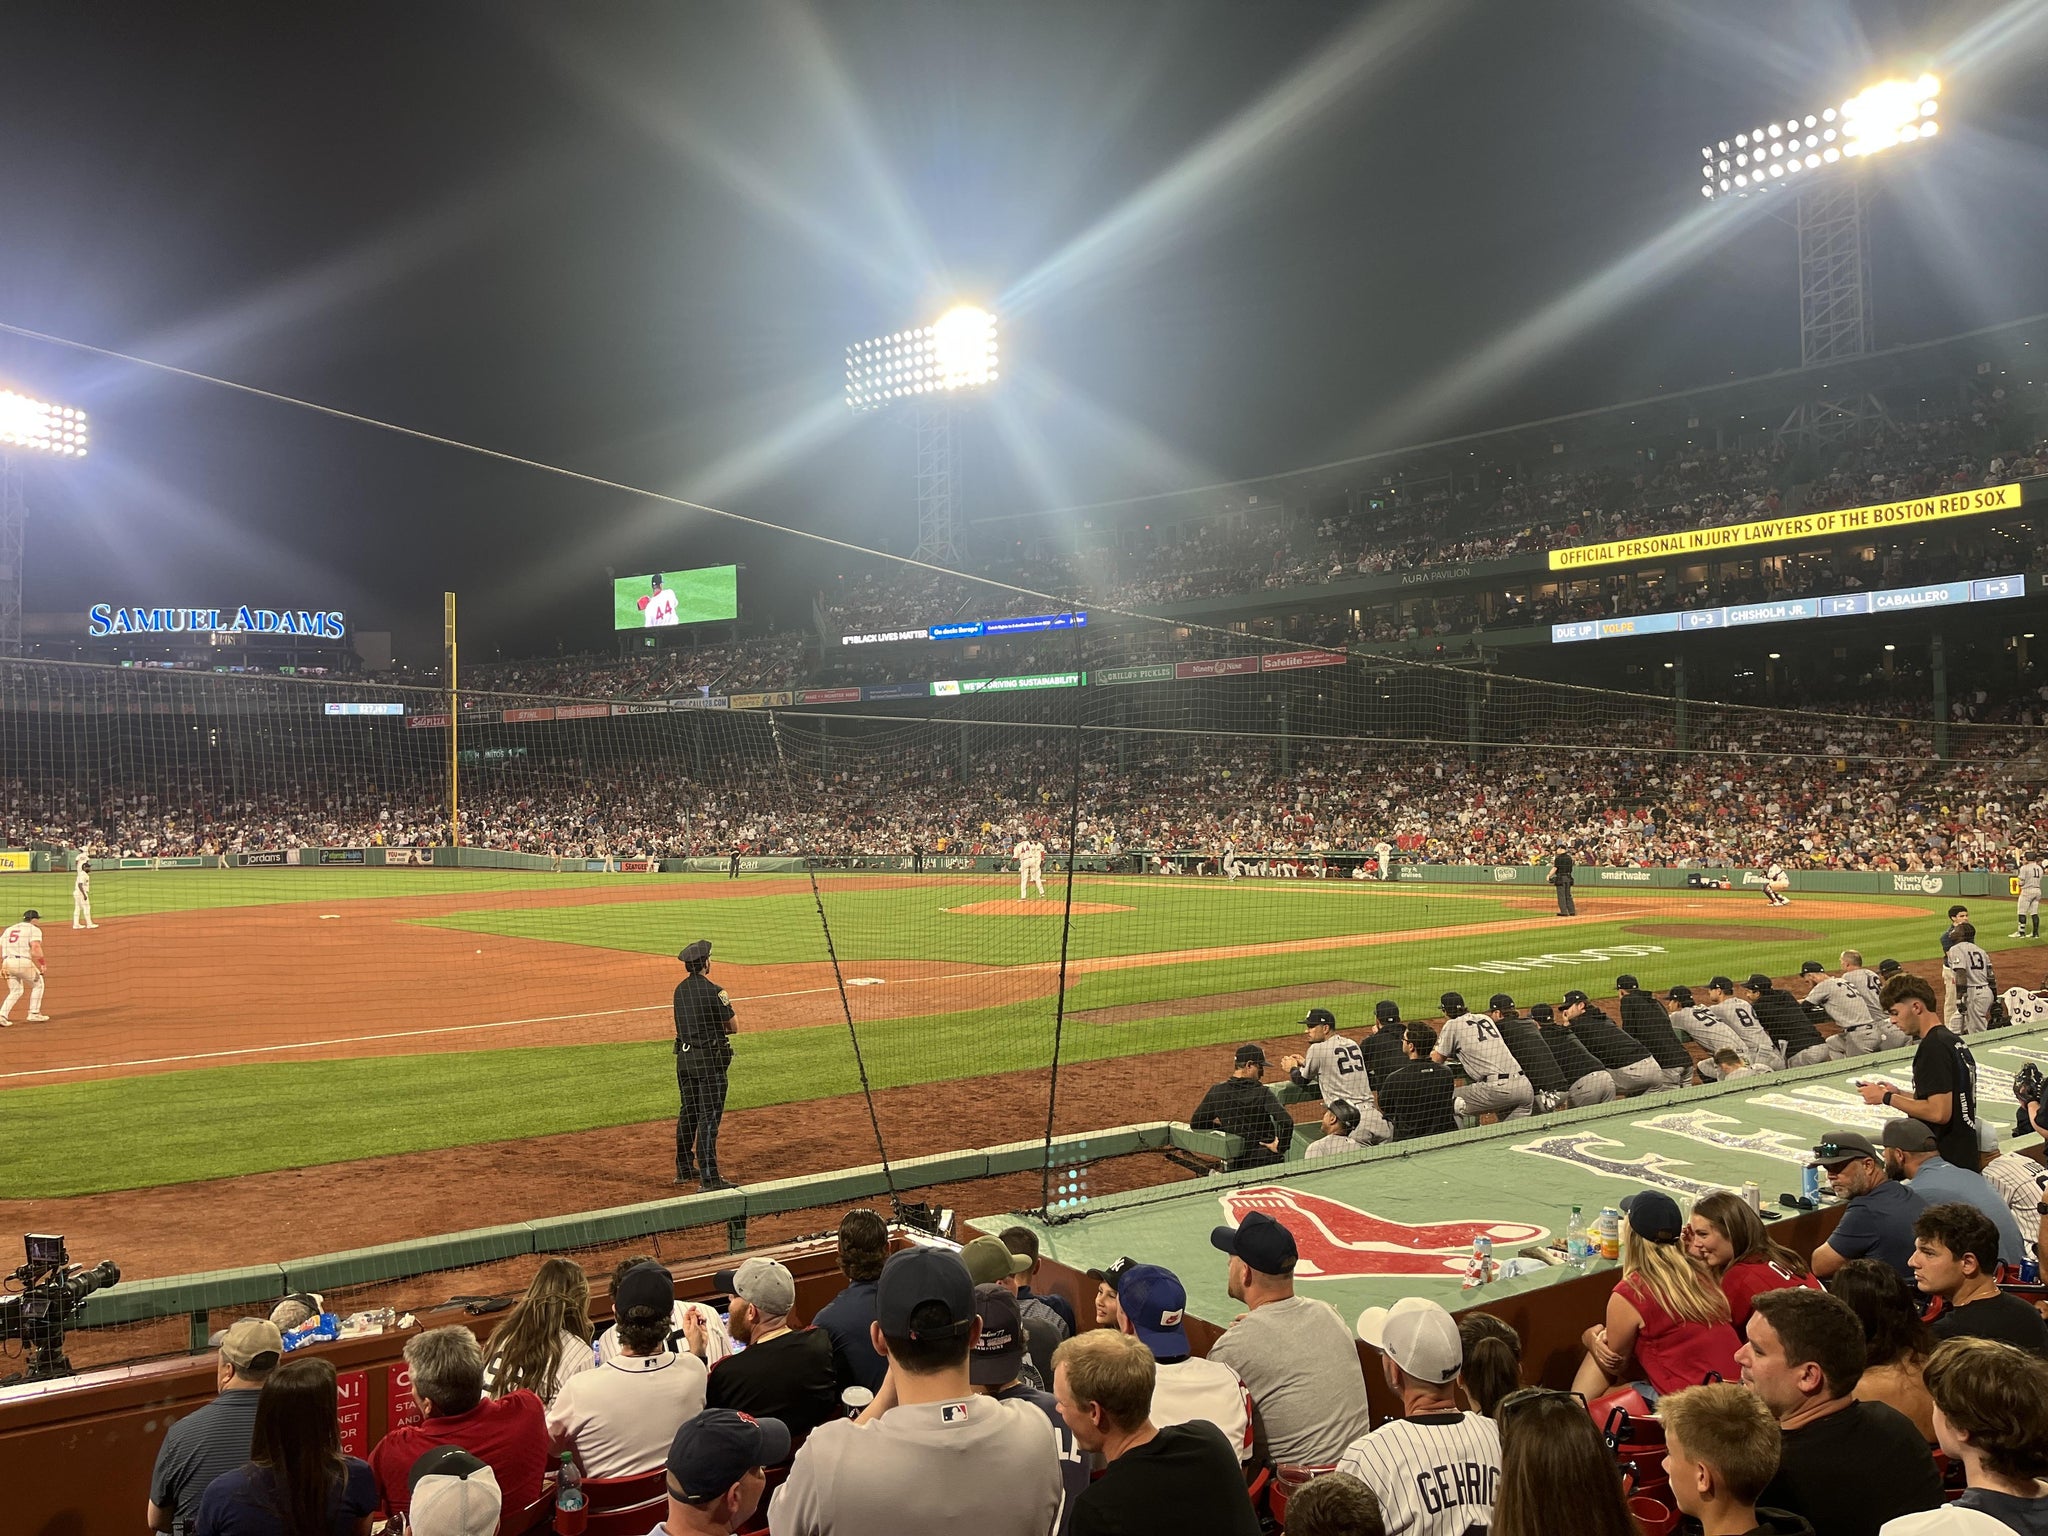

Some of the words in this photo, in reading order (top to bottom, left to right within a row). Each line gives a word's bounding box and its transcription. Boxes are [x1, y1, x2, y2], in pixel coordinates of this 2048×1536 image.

[1560, 546, 1614, 565] OFFICIAL
[1617, 539, 1685, 561] PERSONAL
[1689, 528, 1740, 551] INJURY
[1744, 518, 1812, 541] LAWYERS
[1817, 514, 1836, 530] OF
[1840, 511, 1868, 527] THE
[1874, 504, 1935, 524] BOSTON
[1940, 496, 1970, 513] RED
[1975, 489, 2006, 508] SOX
[1431, 568, 1470, 581] PAVILION
[656, 600, 672, 620] 44
[1557, 626, 1576, 638] DUE
[1579, 625, 1592, 637] UP
[1602, 621, 1634, 634] VOLPE
[1690, 613, 1714, 626] 0-3
[1731, 606, 1785, 621] CHISHOLM
[1789, 604, 1806, 616] JR.
[1833, 599, 1855, 612] 1-2
[1877, 589, 1948, 607] CABALLERO
[1986, 582, 2008, 596] 1-3
[89, 603, 228, 637] SAMUEL
[231, 604, 345, 639] ADAMS
[853, 634, 877, 644] BLACK
[878, 632, 899, 642] LIVES
[899, 630, 928, 640] MATTER
[1192, 663, 1214, 674] Ninety
[1226, 661, 1242, 671] Nine
[1264, 657, 1303, 669] Safelite
[1140, 668, 1171, 679] PICKLES
[987, 679, 1017, 690] DRIVING
[1018, 675, 1078, 687] SUSTAINABILITY
[1601, 871, 1650, 881] smartwater
[1893, 874, 1922, 883] Ninety
[2033, 868, 2040, 879] 11
[1894, 881, 1921, 891] Nine
[9, 930, 20, 944] 5
[1967, 950, 1985, 970] 13
[1466, 1018, 1500, 1042] 78
[1334, 1045, 1366, 1075] 25
[397, 1414, 421, 1427] AND
